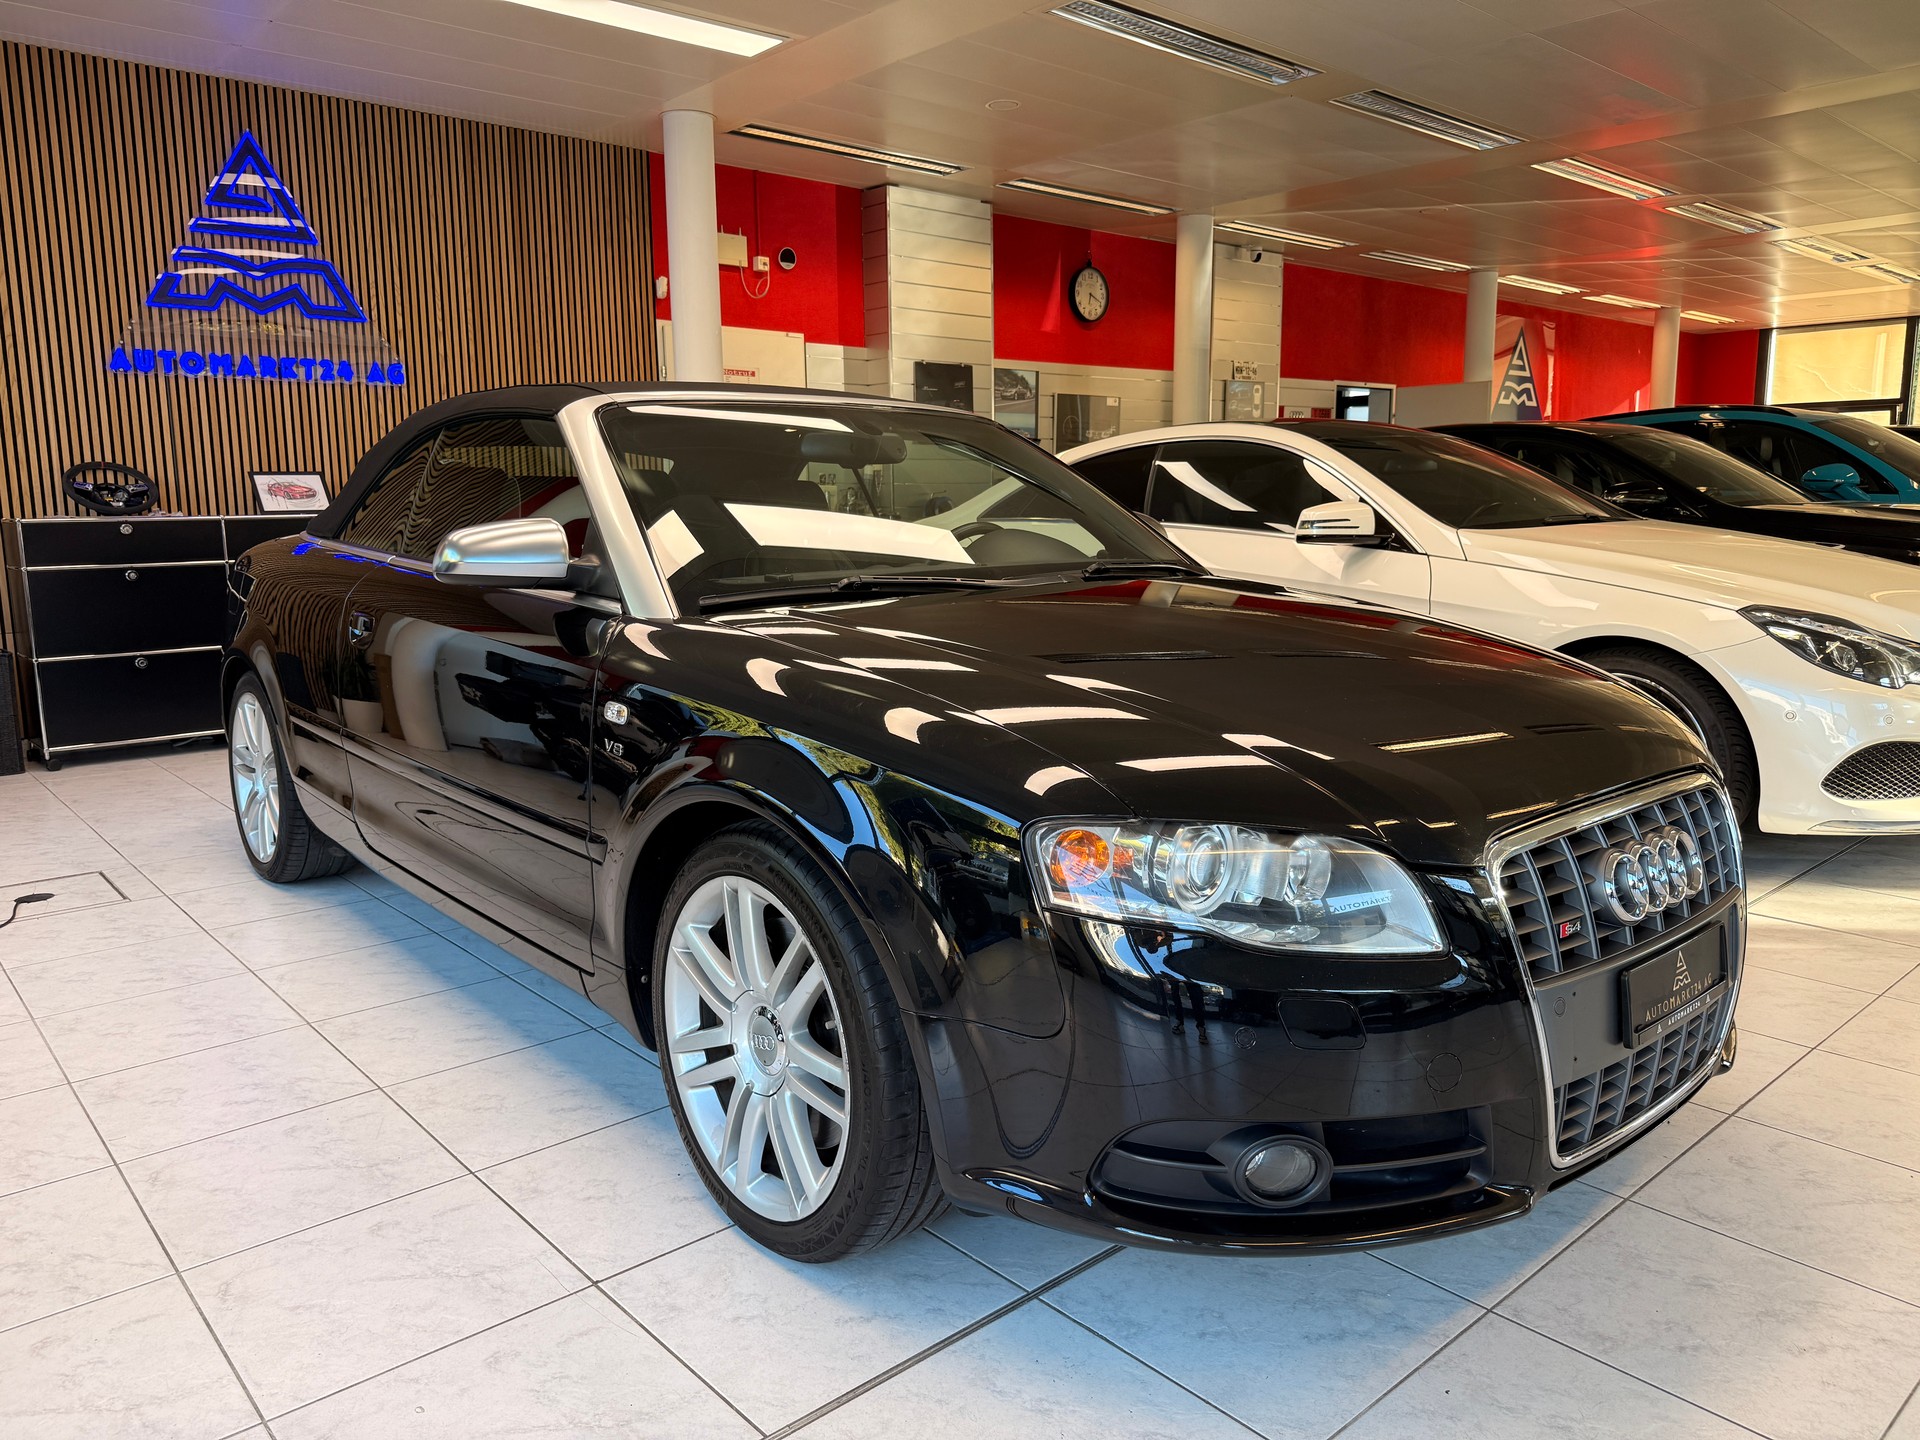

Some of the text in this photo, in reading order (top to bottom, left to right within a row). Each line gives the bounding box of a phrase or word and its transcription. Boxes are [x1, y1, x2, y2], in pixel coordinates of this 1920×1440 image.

[110, 348, 404, 385] AUTOMARKT24 AG
[604, 738, 624, 757] V8
[1565, 921, 1581, 935] S4
[1645, 972, 1712, 1022] AUTOMARKT24 AG
[1668, 1001, 1701, 1026] AUTOMARKT24
